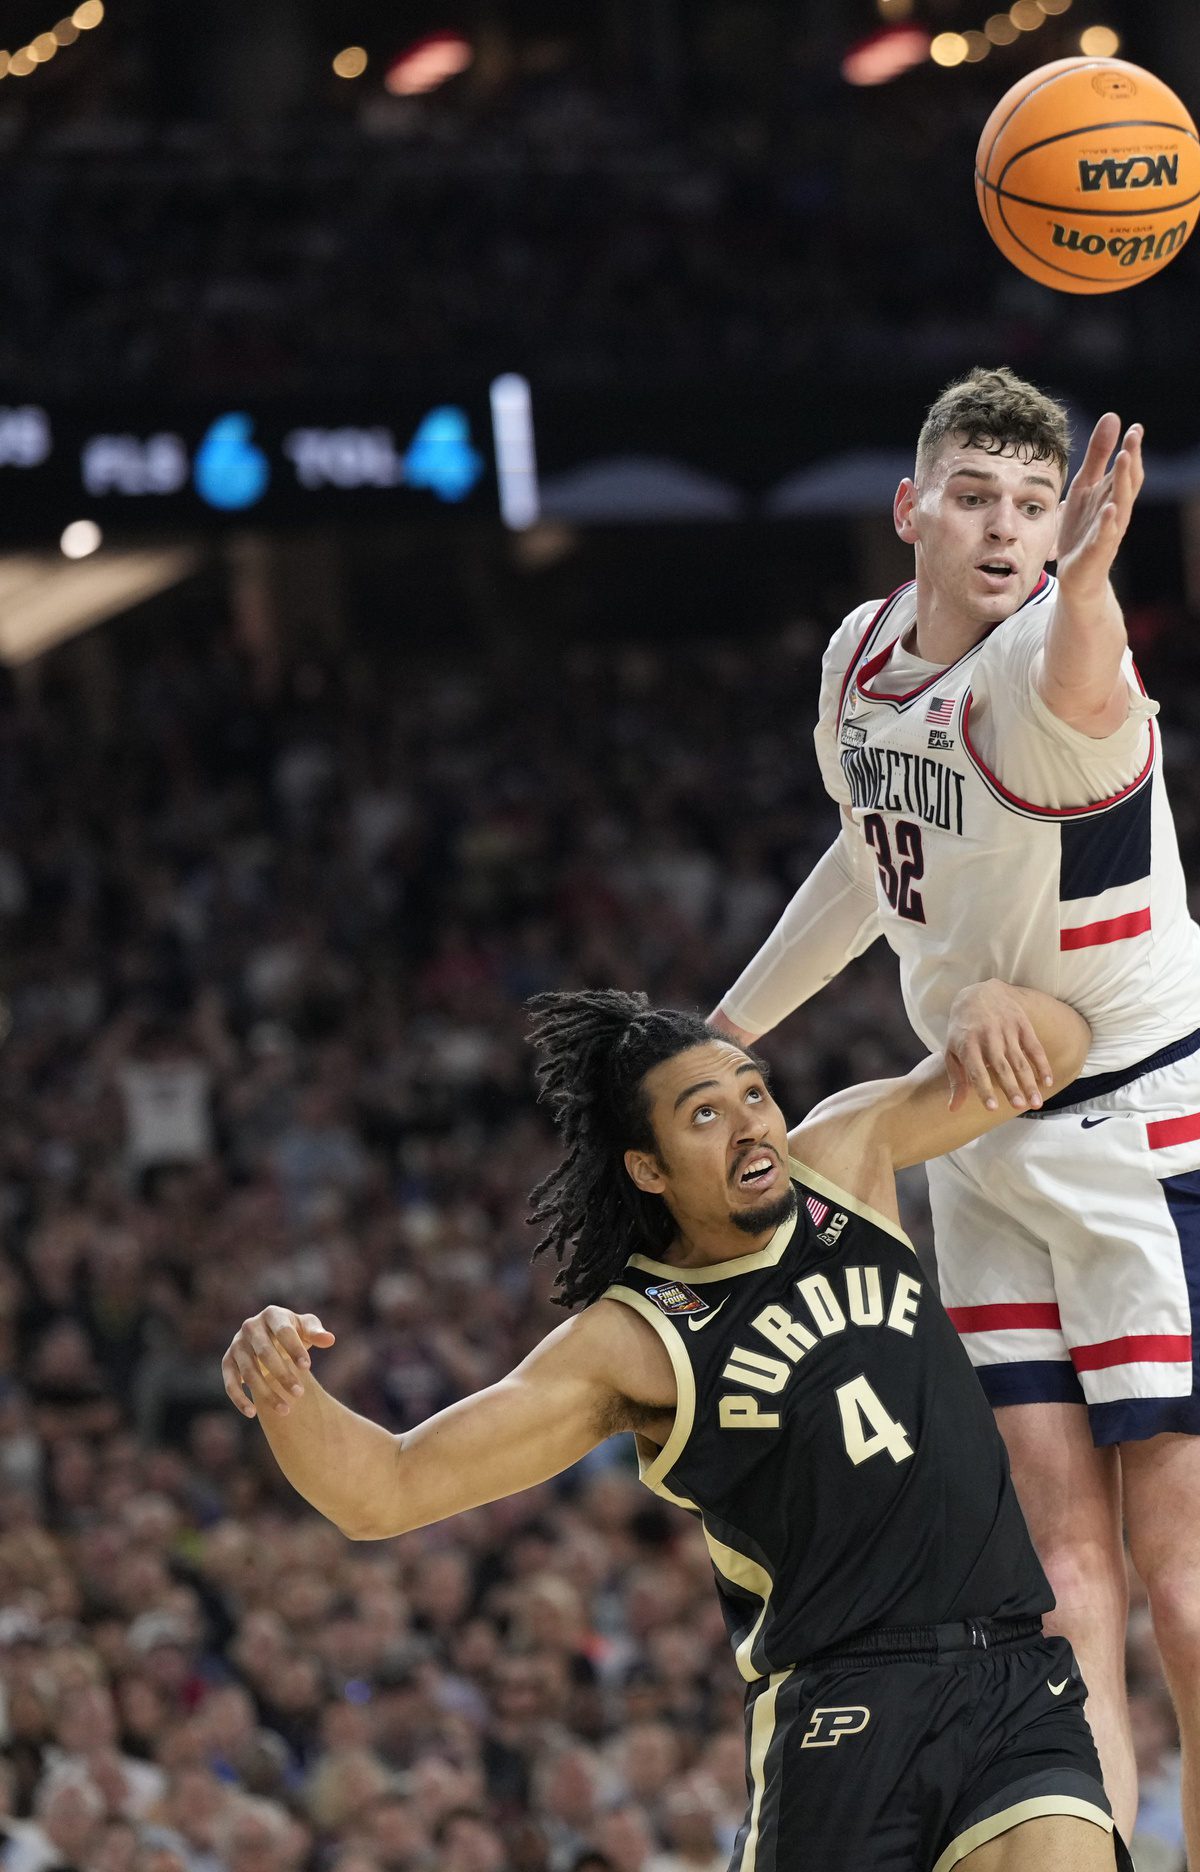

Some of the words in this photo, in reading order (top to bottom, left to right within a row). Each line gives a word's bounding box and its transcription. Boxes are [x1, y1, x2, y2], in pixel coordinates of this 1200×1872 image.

[1078, 154, 1179, 192] NCAA
[1050, 219, 1188, 267] Wilson
[193, 411, 271, 511] 6
[402, 405, 484, 503] 4
[928, 738, 955, 748] EAST
[930, 730, 947, 739] BIG
[863, 812, 927, 925] 32
[657, 1287, 683, 1301] FINAL
[662, 1293, 689, 1306] FOUR
[718, 1265, 923, 1431] PURDUE
[834, 1372, 915, 1467] 4
[800, 1705, 871, 1749] P
